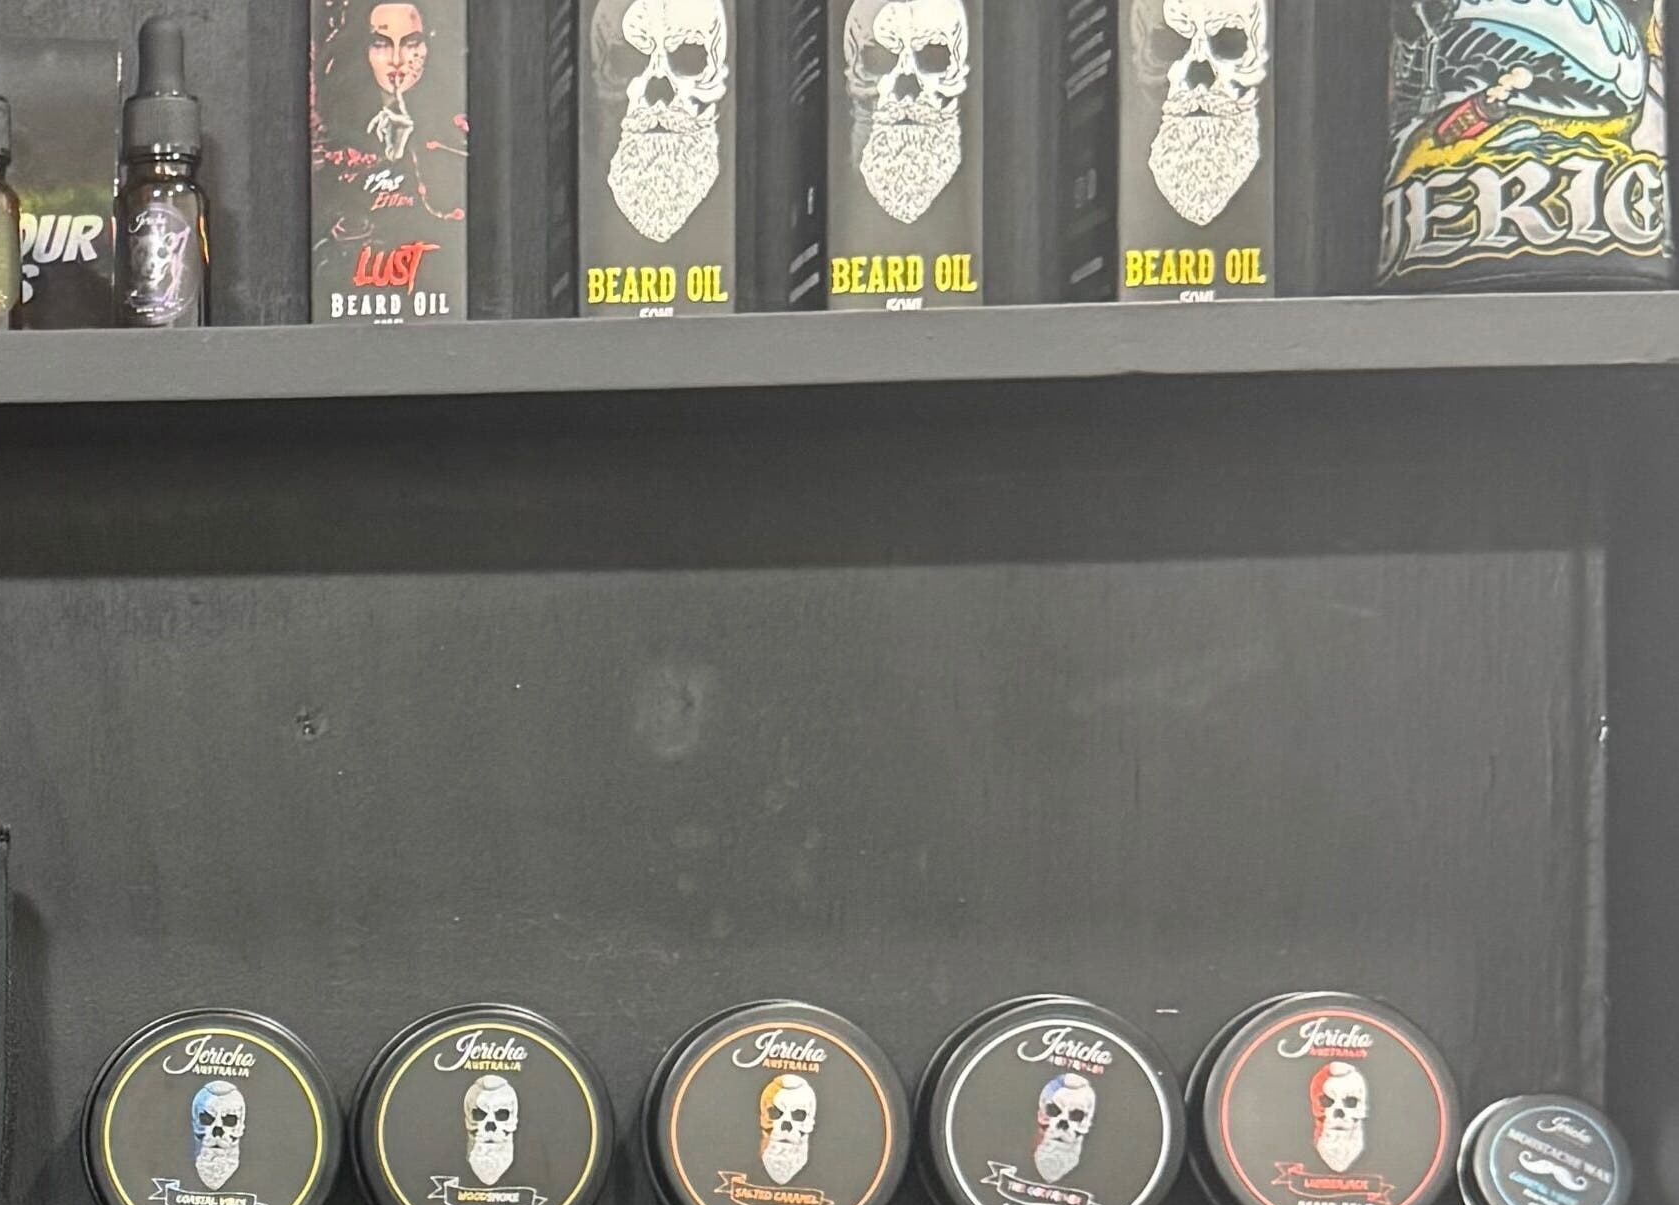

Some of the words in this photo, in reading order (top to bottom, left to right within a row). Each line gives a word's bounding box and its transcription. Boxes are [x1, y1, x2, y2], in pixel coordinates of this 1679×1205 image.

[353, 242, 441, 295] LUST
[588, 267, 676, 303] BEARD
[686, 265, 729, 302] OIL
[831, 254, 924, 294] BEARD
[934, 253, 978, 293] OIL
[1125, 248, 1215, 287] BEARD
[1225, 248, 1267, 284] OIL
[331, 293, 401, 318] BEARD
[414, 292, 450, 316] OIL
[163, 1035, 256, 1075] Jericho
[434, 1030, 528, 1072] Jericho
[732, 1029, 828, 1068] Jericho
[1017, 1027, 1113, 1064] Jericho
[1277, 1017, 1373, 1058] Jericho
